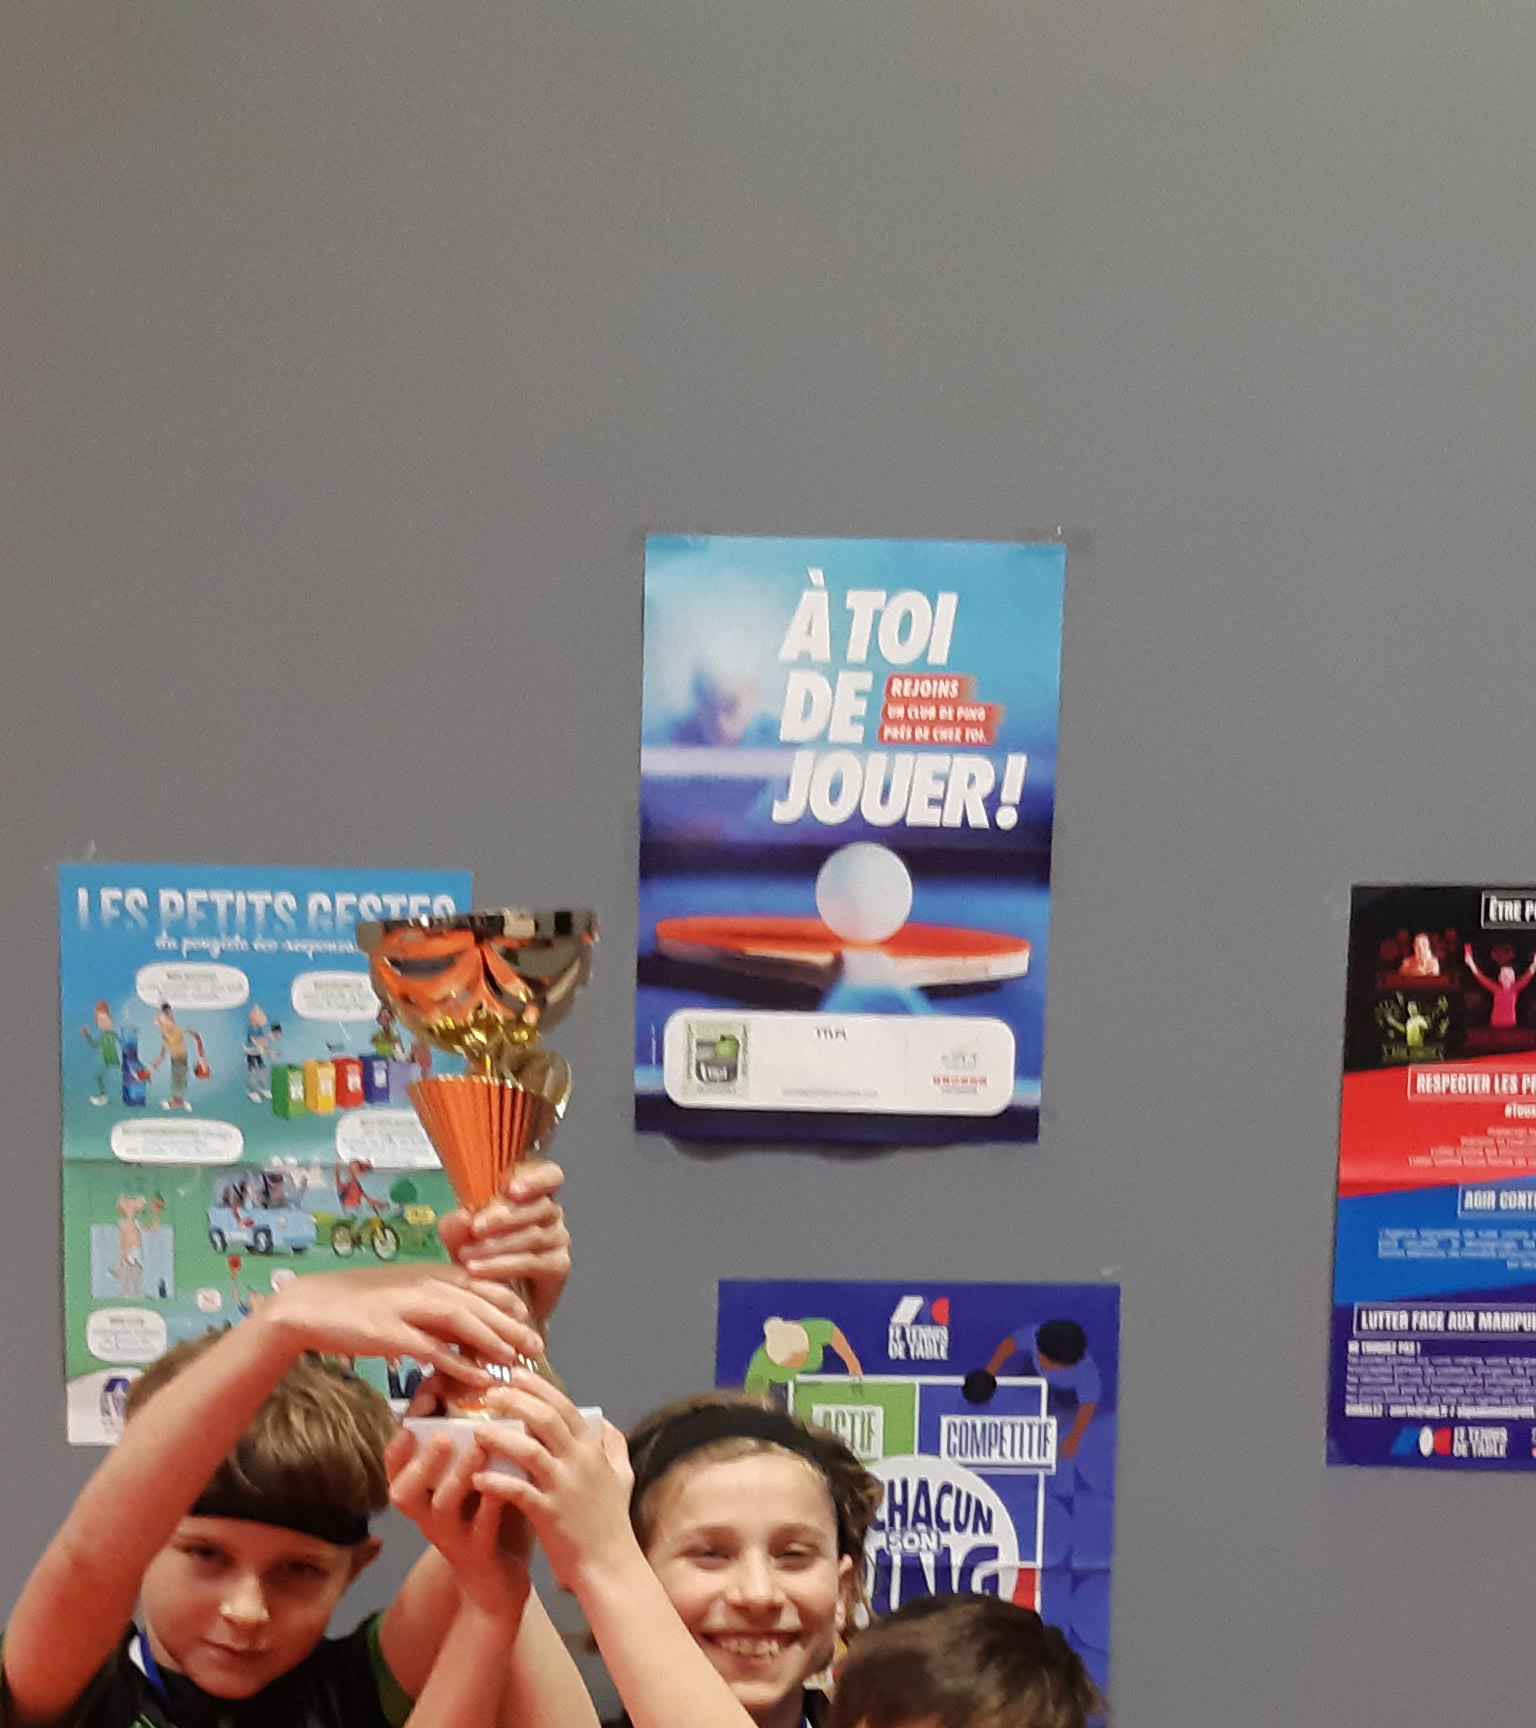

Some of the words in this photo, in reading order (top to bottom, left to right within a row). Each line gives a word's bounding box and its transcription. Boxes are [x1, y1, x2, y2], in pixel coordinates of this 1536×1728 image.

[778, 567, 832, 662] À
[846, 588, 958, 665] TOI
[891, 678, 960, 698] REJOINS
[779, 669, 873, 744] DE
[887, 704, 904, 720] UN
[907, 704, 937, 721] CLUB
[939, 705, 955, 721] DE
[957, 706, 986, 722] PING
[932, 727, 962, 743] CHEZ
[77, 886, 149, 931] LES
[158, 888, 297, 933] PETITS
[1489, 896, 1521, 922] ÊTRE
[1416, 1071, 1490, 1095] RESPECTER
[1494, 1073, 1519, 1095] LES
[1464, 1189, 1496, 1211] AGIR
[1361, 1308, 1410, 1331] LUTTER
[1412, 1310, 1445, 1331] FACE
[1448, 1310, 1475, 1331] AUX
[885, 1528, 942, 1555] SON
